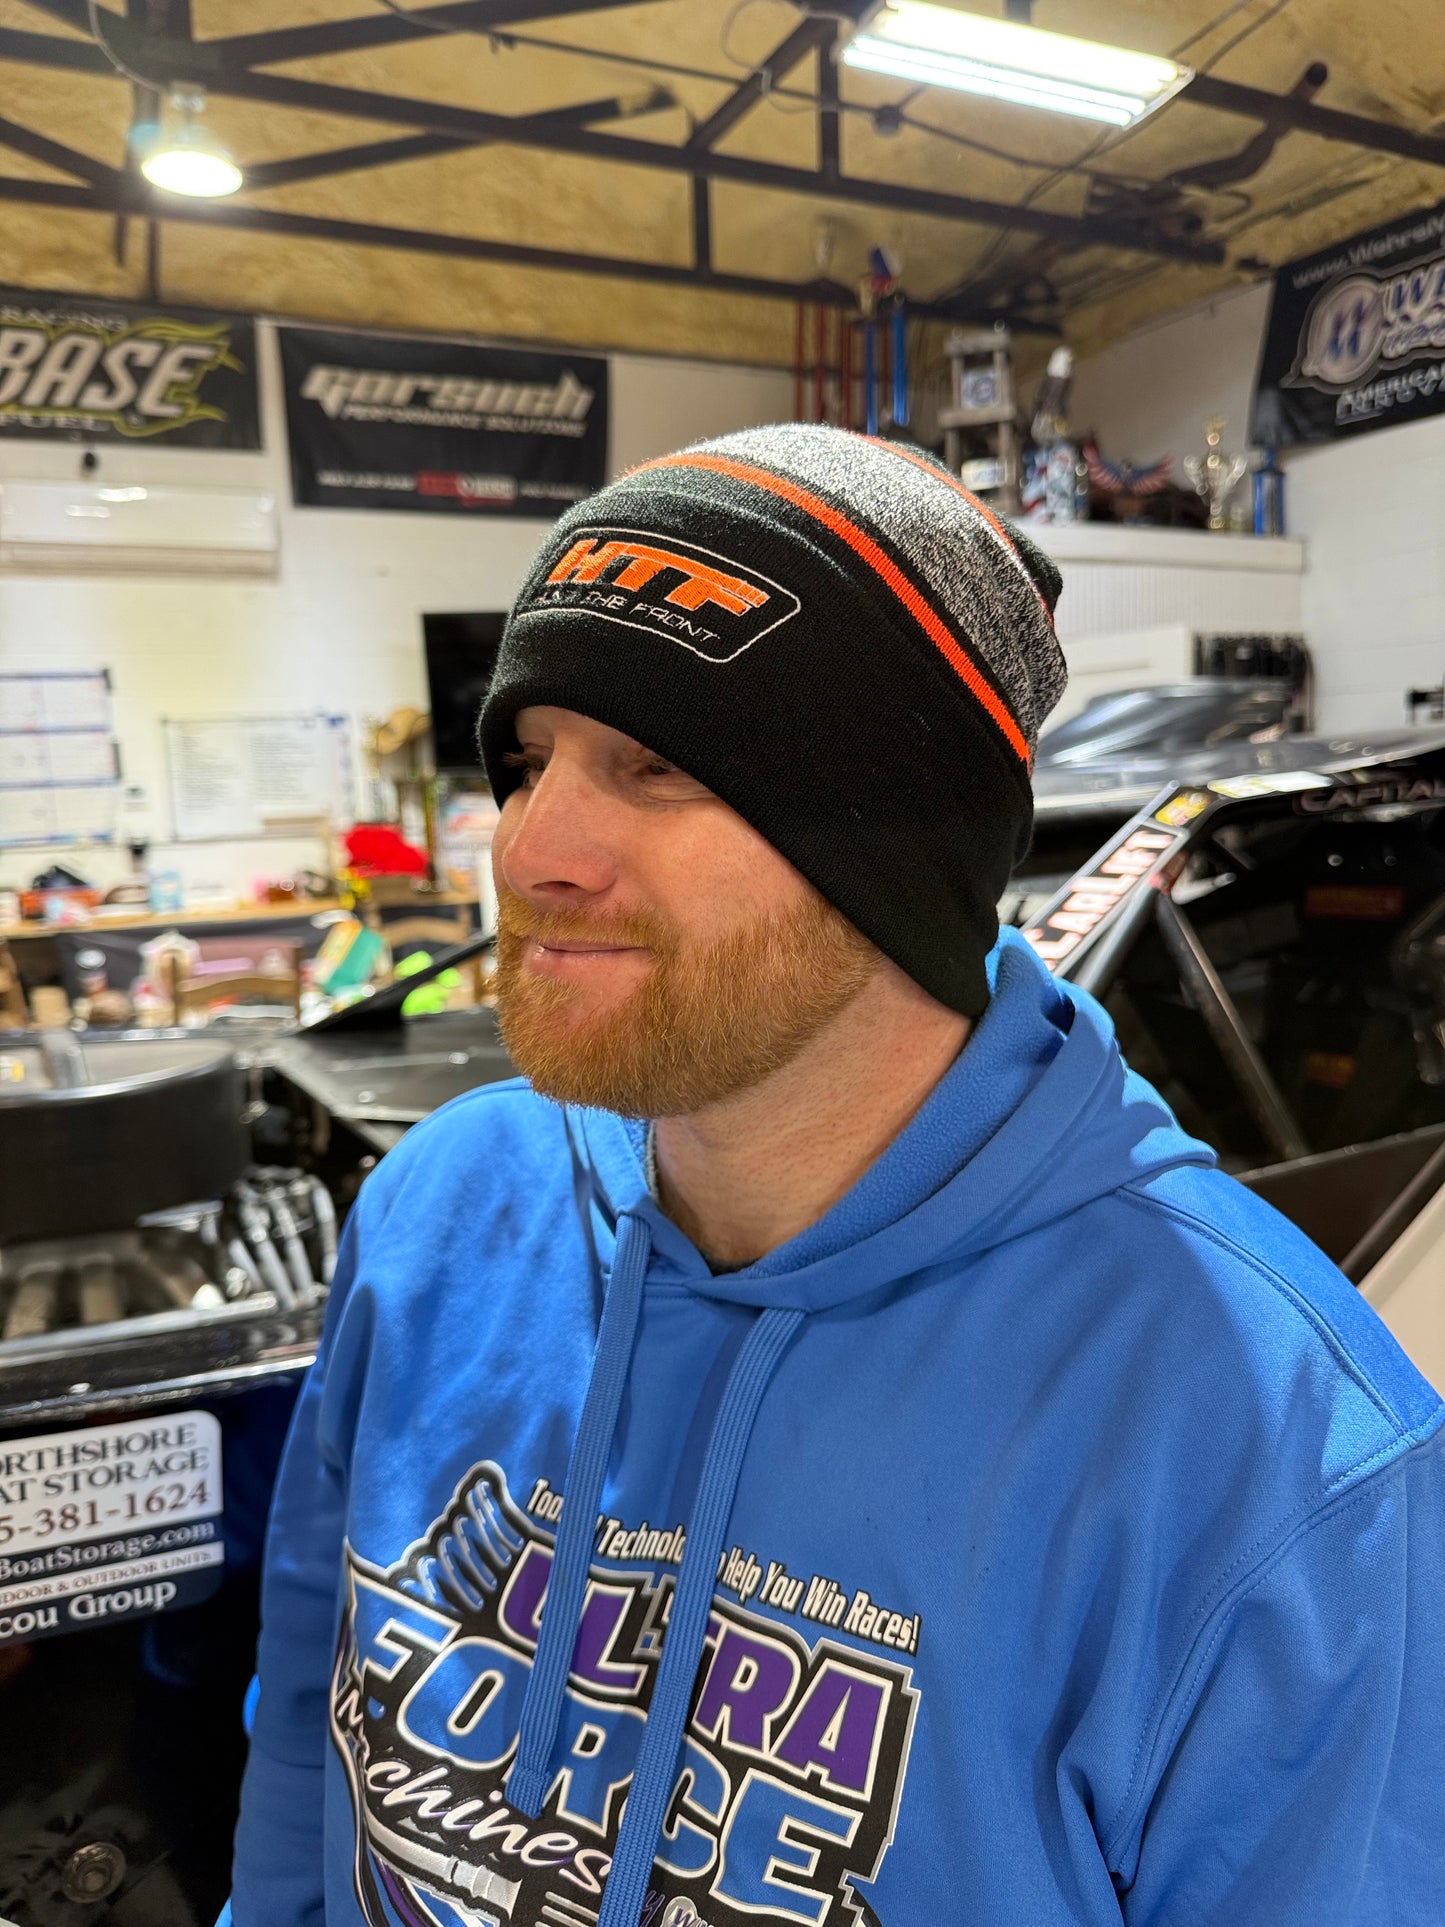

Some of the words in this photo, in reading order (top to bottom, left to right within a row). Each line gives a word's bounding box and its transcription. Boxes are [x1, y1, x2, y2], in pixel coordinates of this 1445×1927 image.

[0, 1422, 196, 1478] RTHSHORE
[44, 1448, 209, 1499] STORAGE
[0, 1586, 54, 1604] DOOR
[74, 1563, 158, 1589] OUTDOOR
[527, 1478, 564, 1524] Too
[597, 1518, 687, 1566] Technolo
[722, 1545, 763, 1606] Help
[758, 1560, 806, 1615] You
[801, 1574, 848, 1627] Win
[843, 1590, 920, 1654] Races!
[68, 1581, 177, 1621] Group
